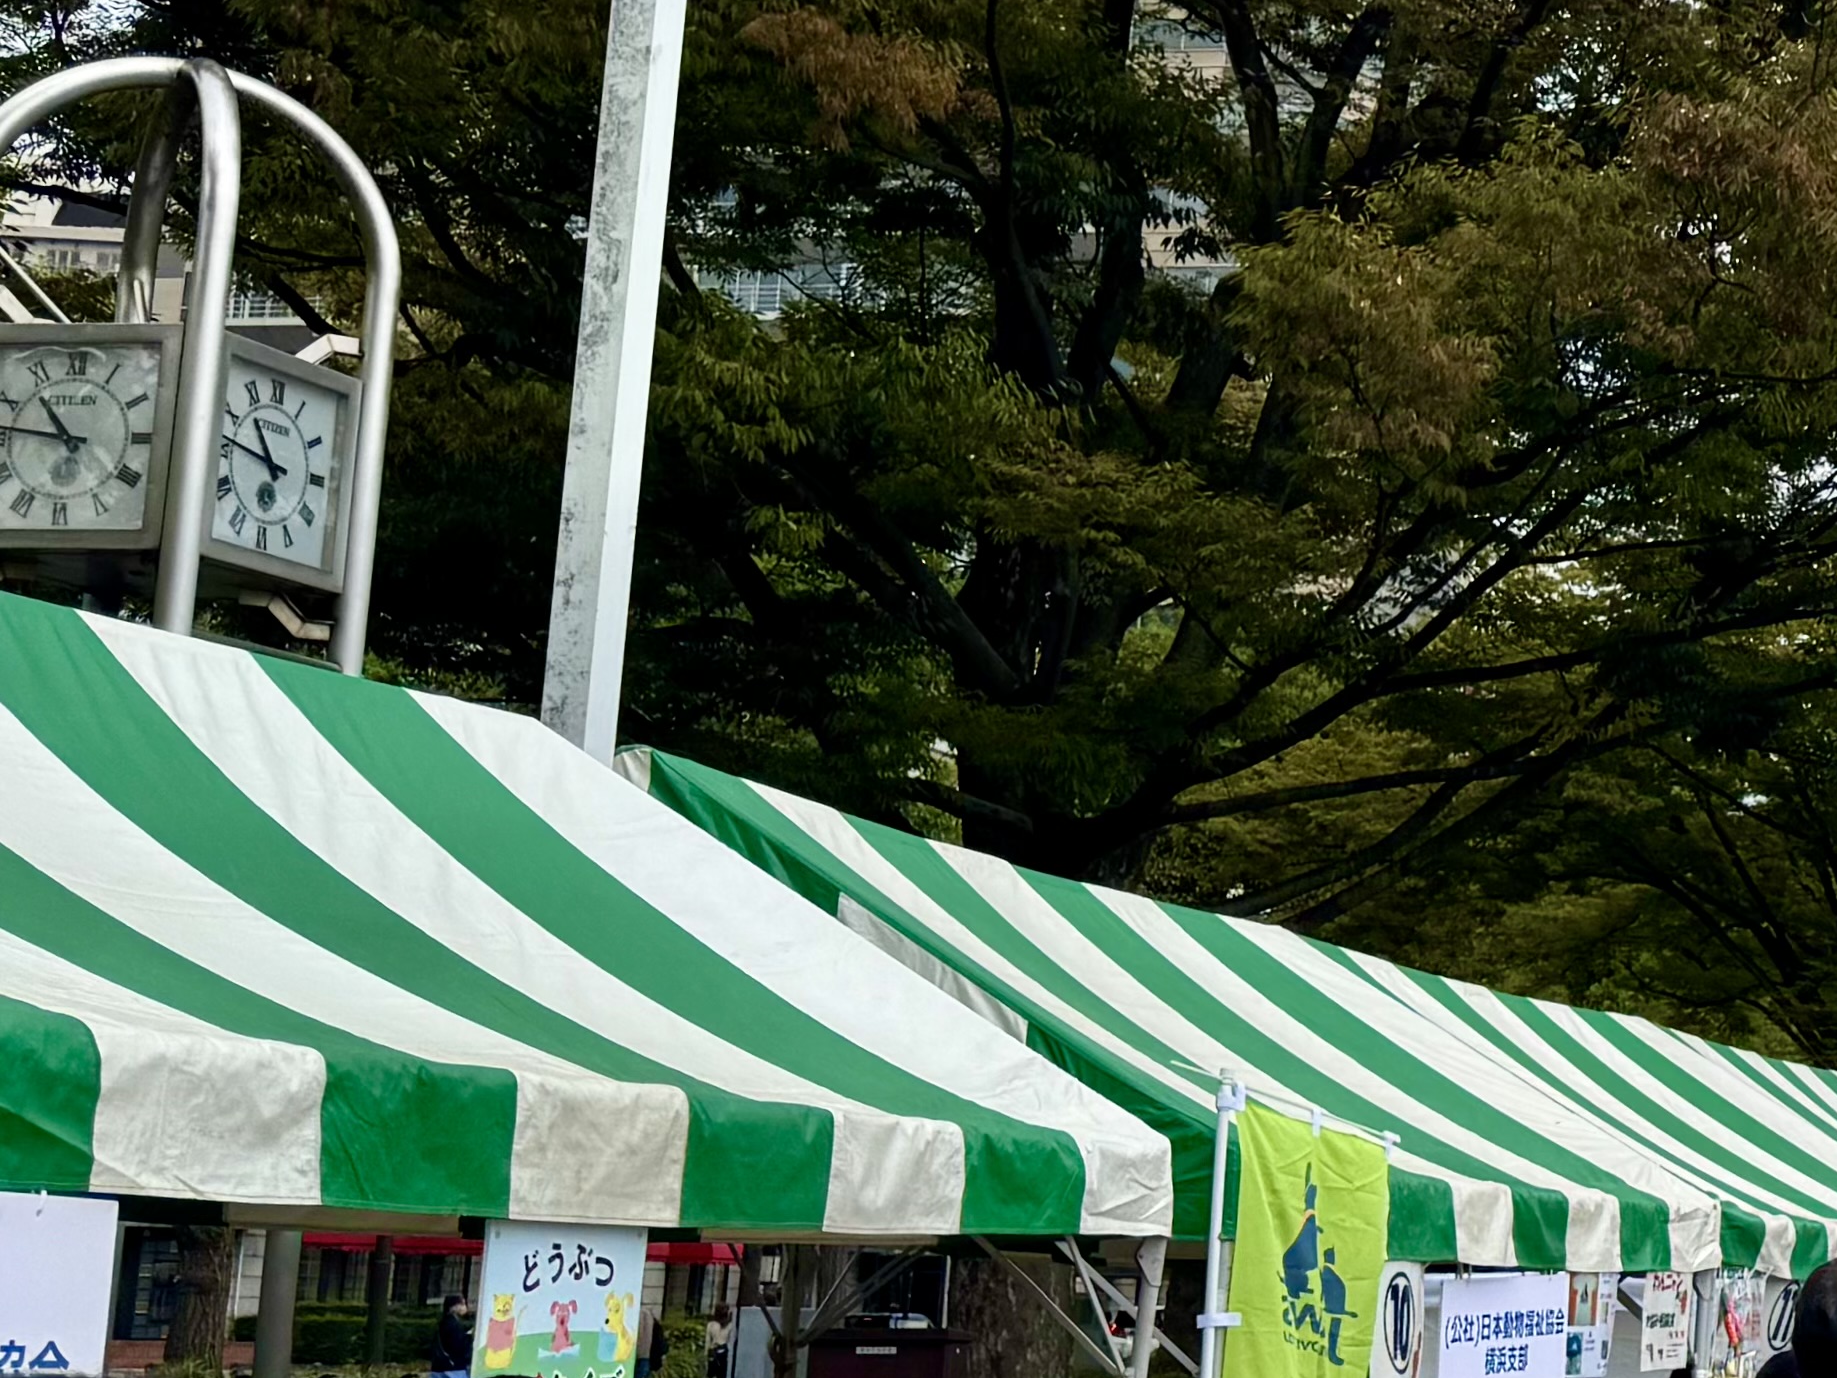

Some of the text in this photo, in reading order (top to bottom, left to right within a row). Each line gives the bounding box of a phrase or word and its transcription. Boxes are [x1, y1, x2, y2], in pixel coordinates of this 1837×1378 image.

[257, 418, 290, 437] CITIZEN
[522, 1241, 616, 1293] どうぶつ
[1389, 1282, 1411, 1362] 10
[1445, 1307, 1565, 1349] (公社)日本動物福祉協会
[1484, 1343, 1529, 1376] 横浜支部
